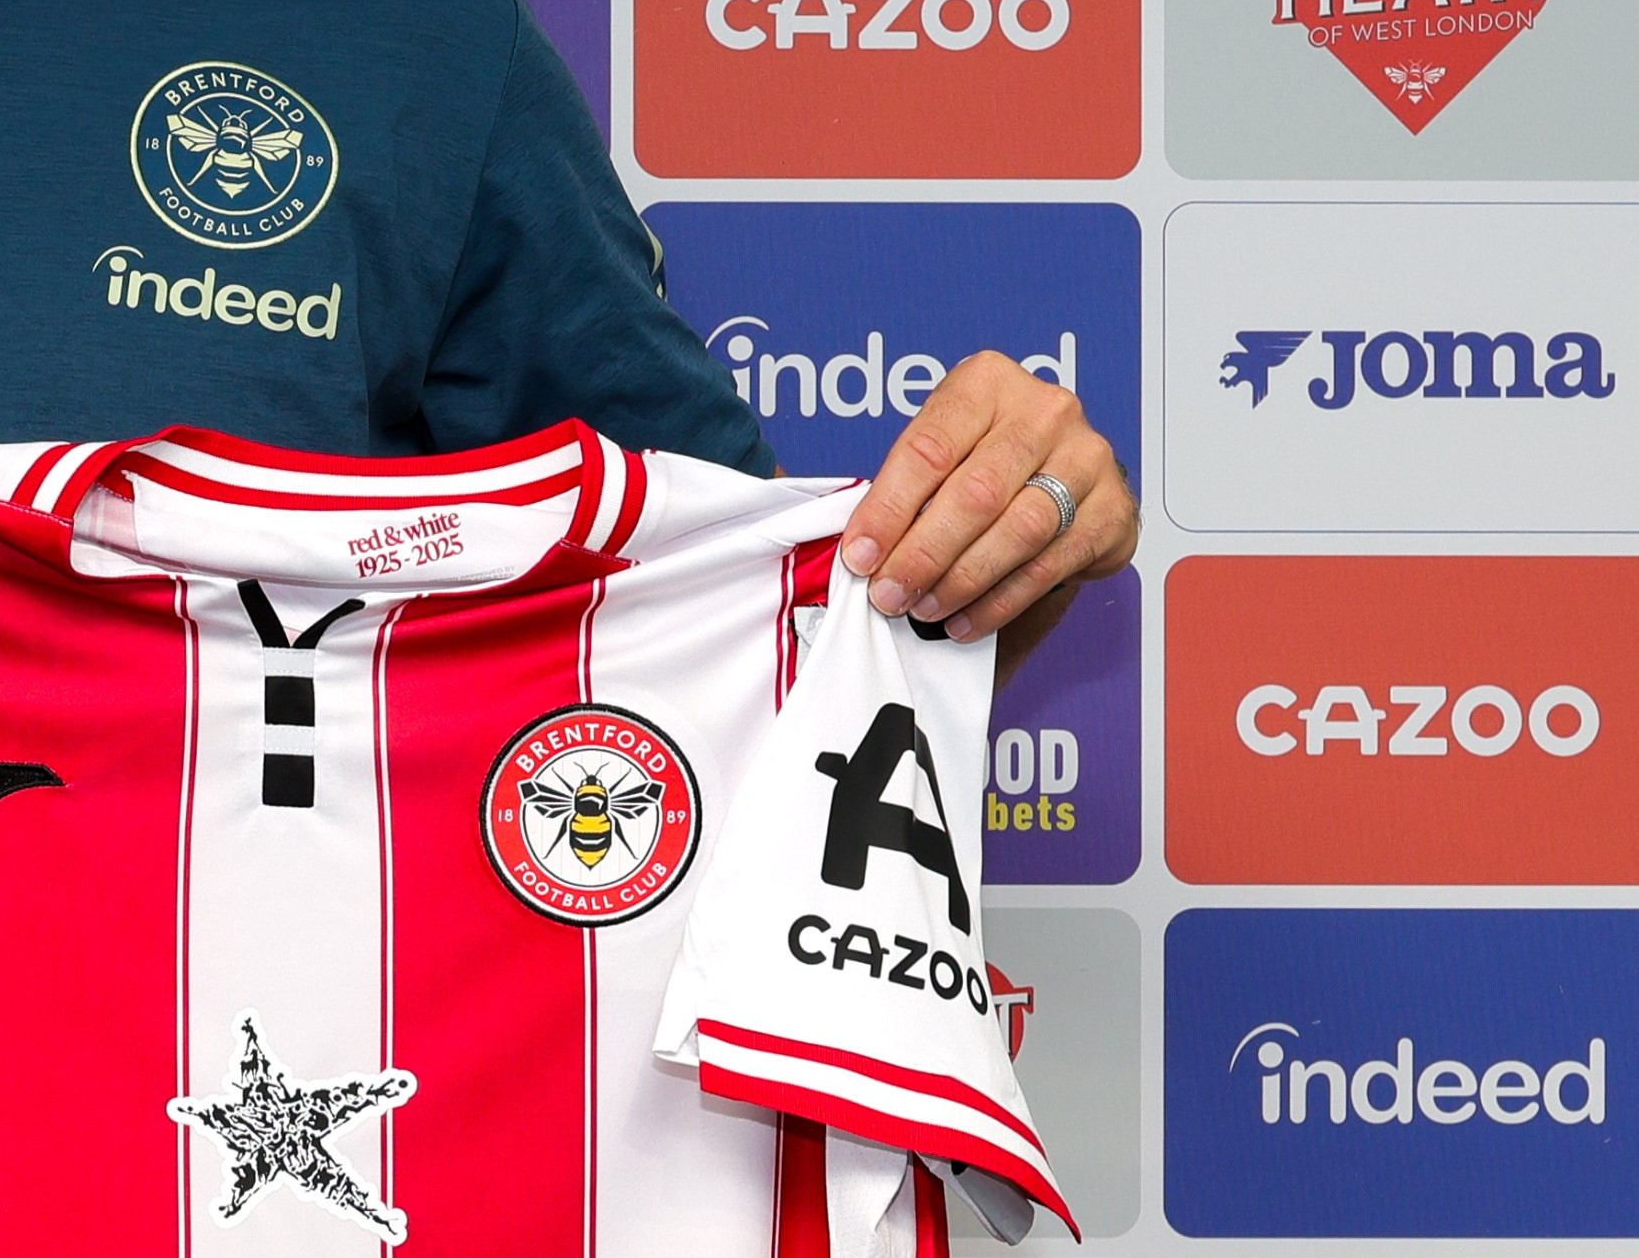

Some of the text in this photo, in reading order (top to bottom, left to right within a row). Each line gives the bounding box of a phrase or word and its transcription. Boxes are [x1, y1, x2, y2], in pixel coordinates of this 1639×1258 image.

[1309, 9, 1533, 47] OF WEST LONDON
[164, 72, 305, 123] BRENTFORD
[145, 138, 160, 150] 18
[306, 155, 324, 168] 89
[159, 187, 304, 236] FOOTBALL CLUB
[92, 245, 341, 340] indeed
[705, 315, 1077, 418] inded
[347, 511, 462, 556] red & white
[355, 550, 402, 579] 1925
[411, 533, 463, 567] 2025
[1235, 684, 1600, 757] CAZOO
[515, 723, 667, 773] BRENTFORD
[498, 809, 513, 822] 18
[666, 810, 686, 824] 89
[987, 792, 1077, 832] bets
[514, 861, 667, 910] FOOTBALL CLUB
[788, 914, 989, 1016] CAZOO
[1229, 1022, 1606, 1125] indeed
